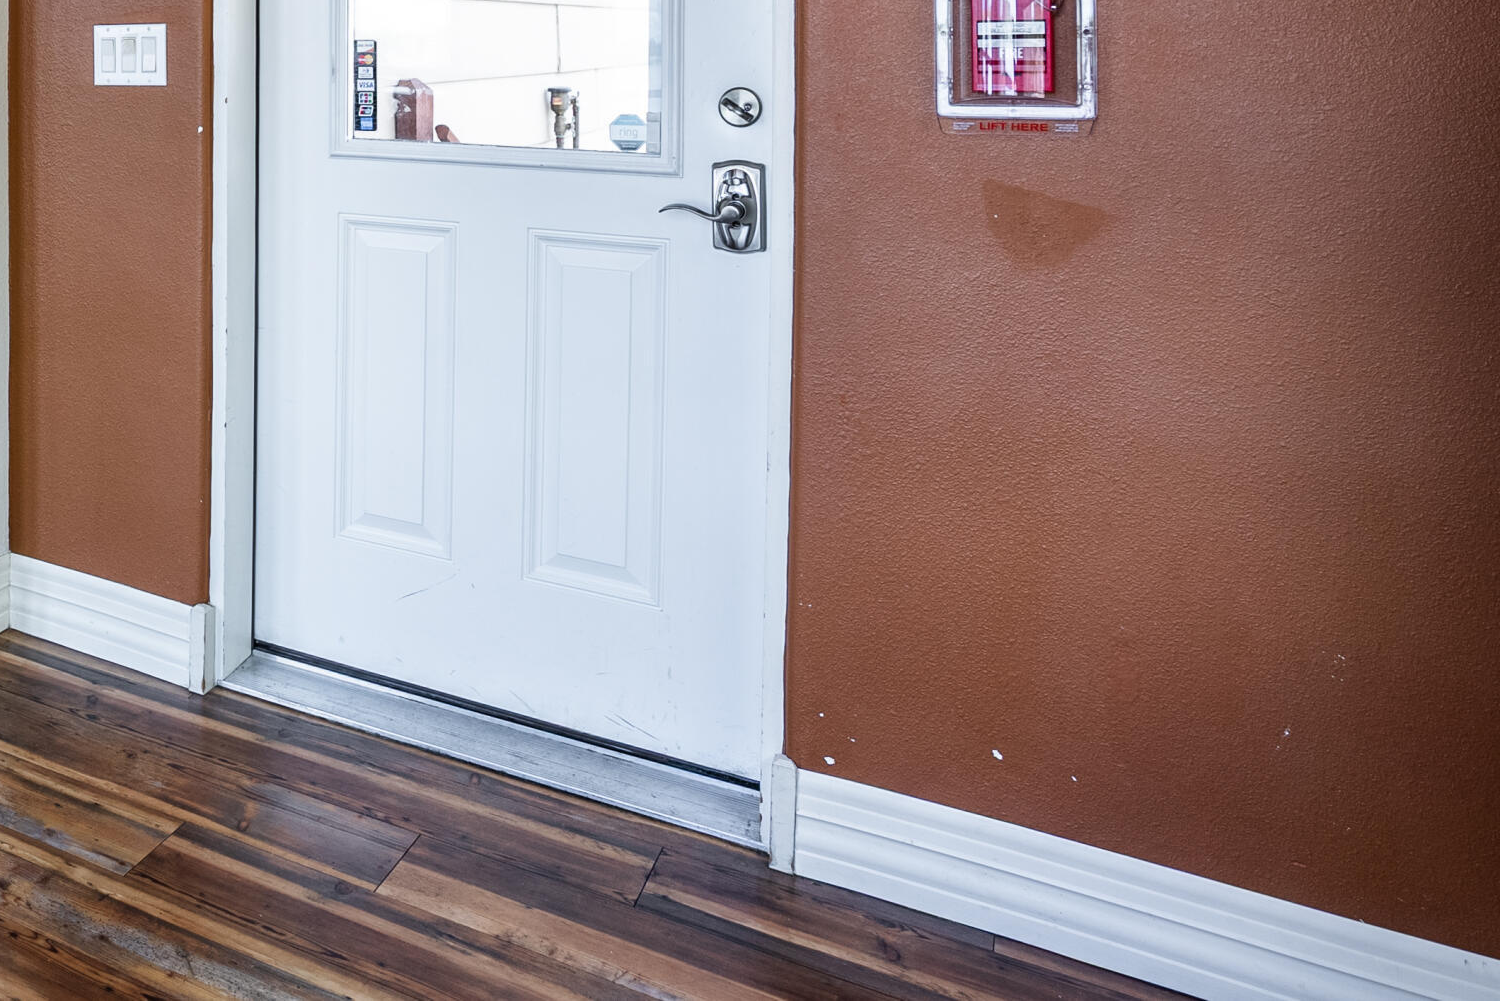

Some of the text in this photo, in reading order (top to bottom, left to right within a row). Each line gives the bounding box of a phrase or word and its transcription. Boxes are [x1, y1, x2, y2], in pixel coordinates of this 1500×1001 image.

[999, 47, 1024, 59] FRE
[619, 127, 638, 139] ring
[979, 122, 1006, 131] LIFT
[1011, 123, 1049, 132] HERE
